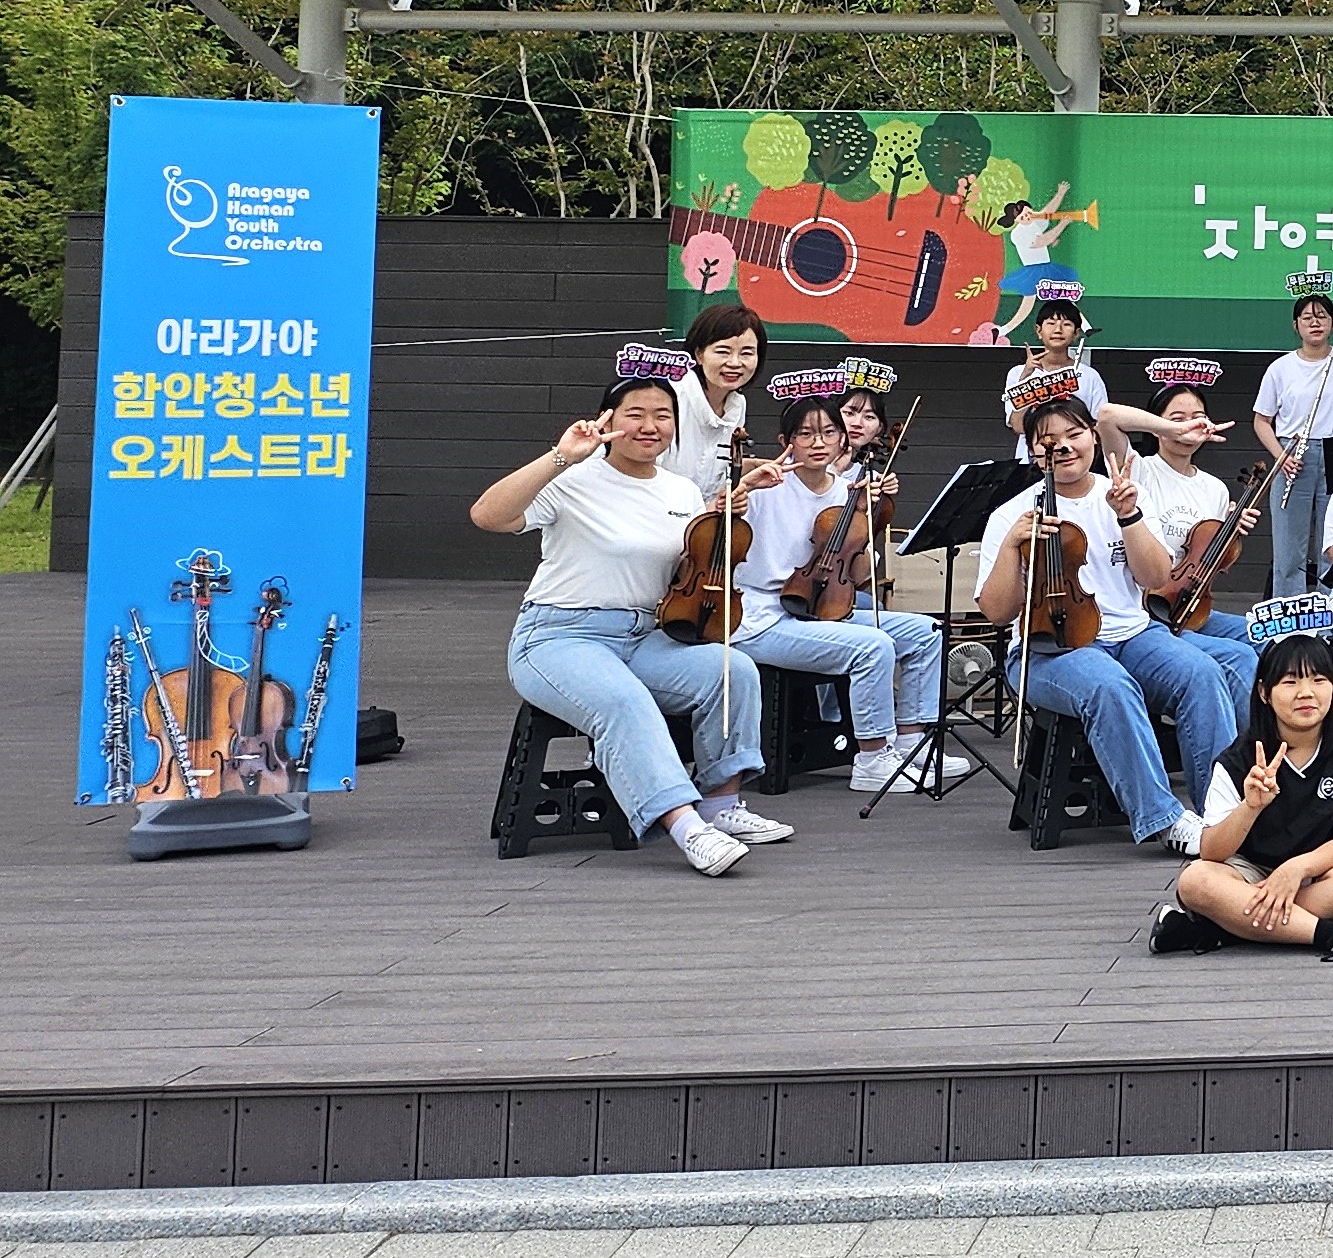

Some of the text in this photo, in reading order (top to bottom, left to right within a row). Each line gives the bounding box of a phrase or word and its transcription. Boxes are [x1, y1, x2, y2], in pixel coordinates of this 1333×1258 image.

[227, 182, 310, 204] Aragaya
[227, 200, 295, 217] Haman
[225, 217, 279, 234] Youth
[225, 233, 323, 253] Orchestra
[156, 318, 320, 357] 아라가야
[626, 347, 689, 367] 함께해요
[1154, 360, 1218, 374] 에너지SAVE
[774, 370, 844, 386] 에너지SAVE
[1009, 370, 1074, 397] 버리면 쓰레기
[1153, 370, 1214, 384] 지구는SAFE
[112, 370, 351, 419] 함안청소년
[776, 382, 843, 398] 지구는SAFE
[1012, 379, 1078, 406] 모으면 자원
[108, 433, 352, 480] 오케스트라
[1256, 595, 1327, 622] 푸른 지구는
[1251, 611, 1333, 641] 우리의 미래
